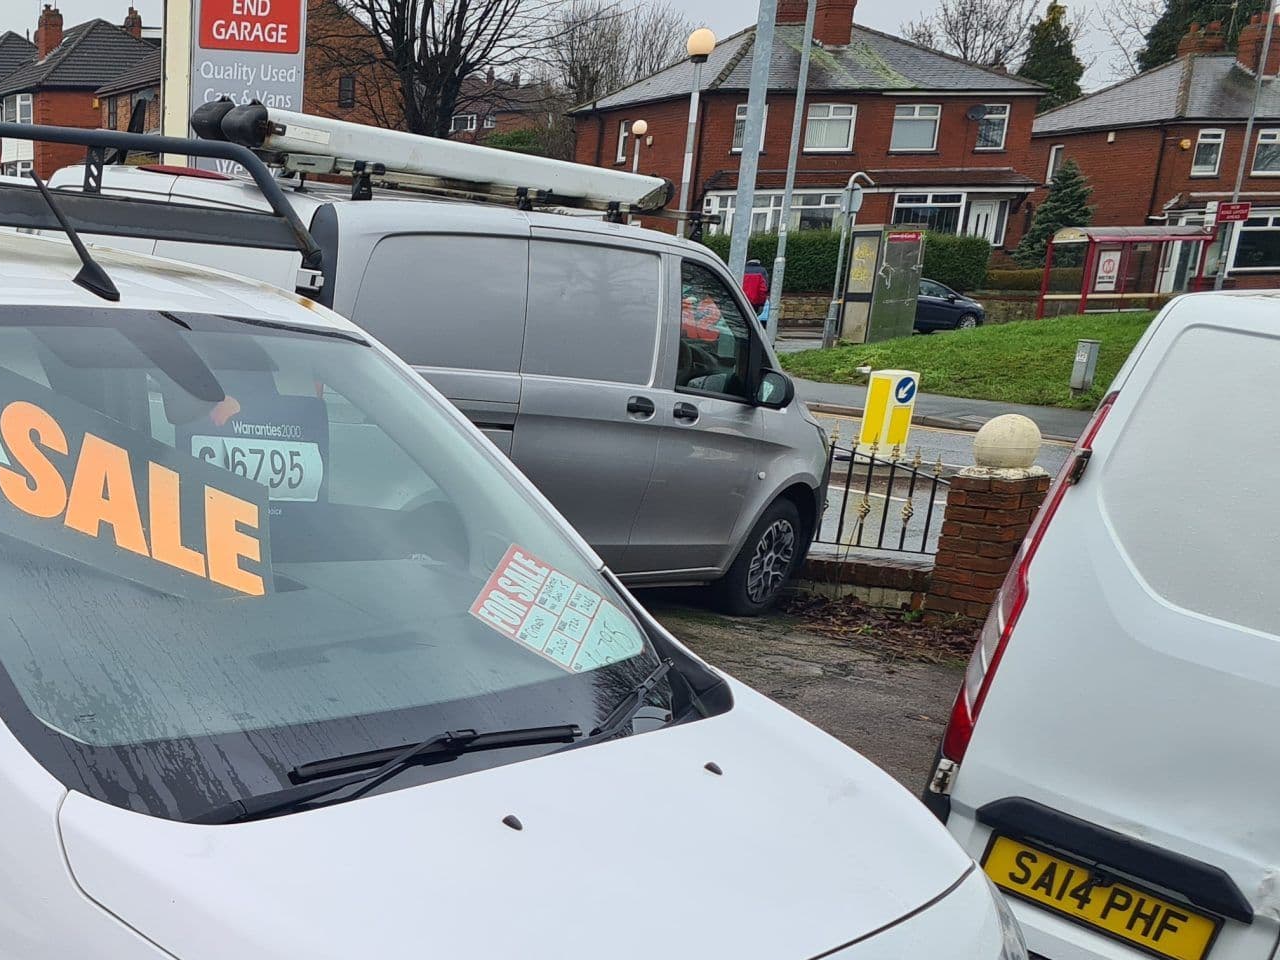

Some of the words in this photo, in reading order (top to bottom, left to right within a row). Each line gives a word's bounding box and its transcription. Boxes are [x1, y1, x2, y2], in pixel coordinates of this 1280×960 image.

[232, 0, 271, 16] END
[212, 20, 288, 43] GARAGE
[200, 61, 257, 85] Quality
[260, 64, 297, 82] Used
[255, 90, 292, 107] Vans
[497, 551, 551, 602] SALE
[478, 589, 529, 634] FOR
[1008, 851, 1096, 910] SA14
[1100, 886, 1188, 942] PHF
